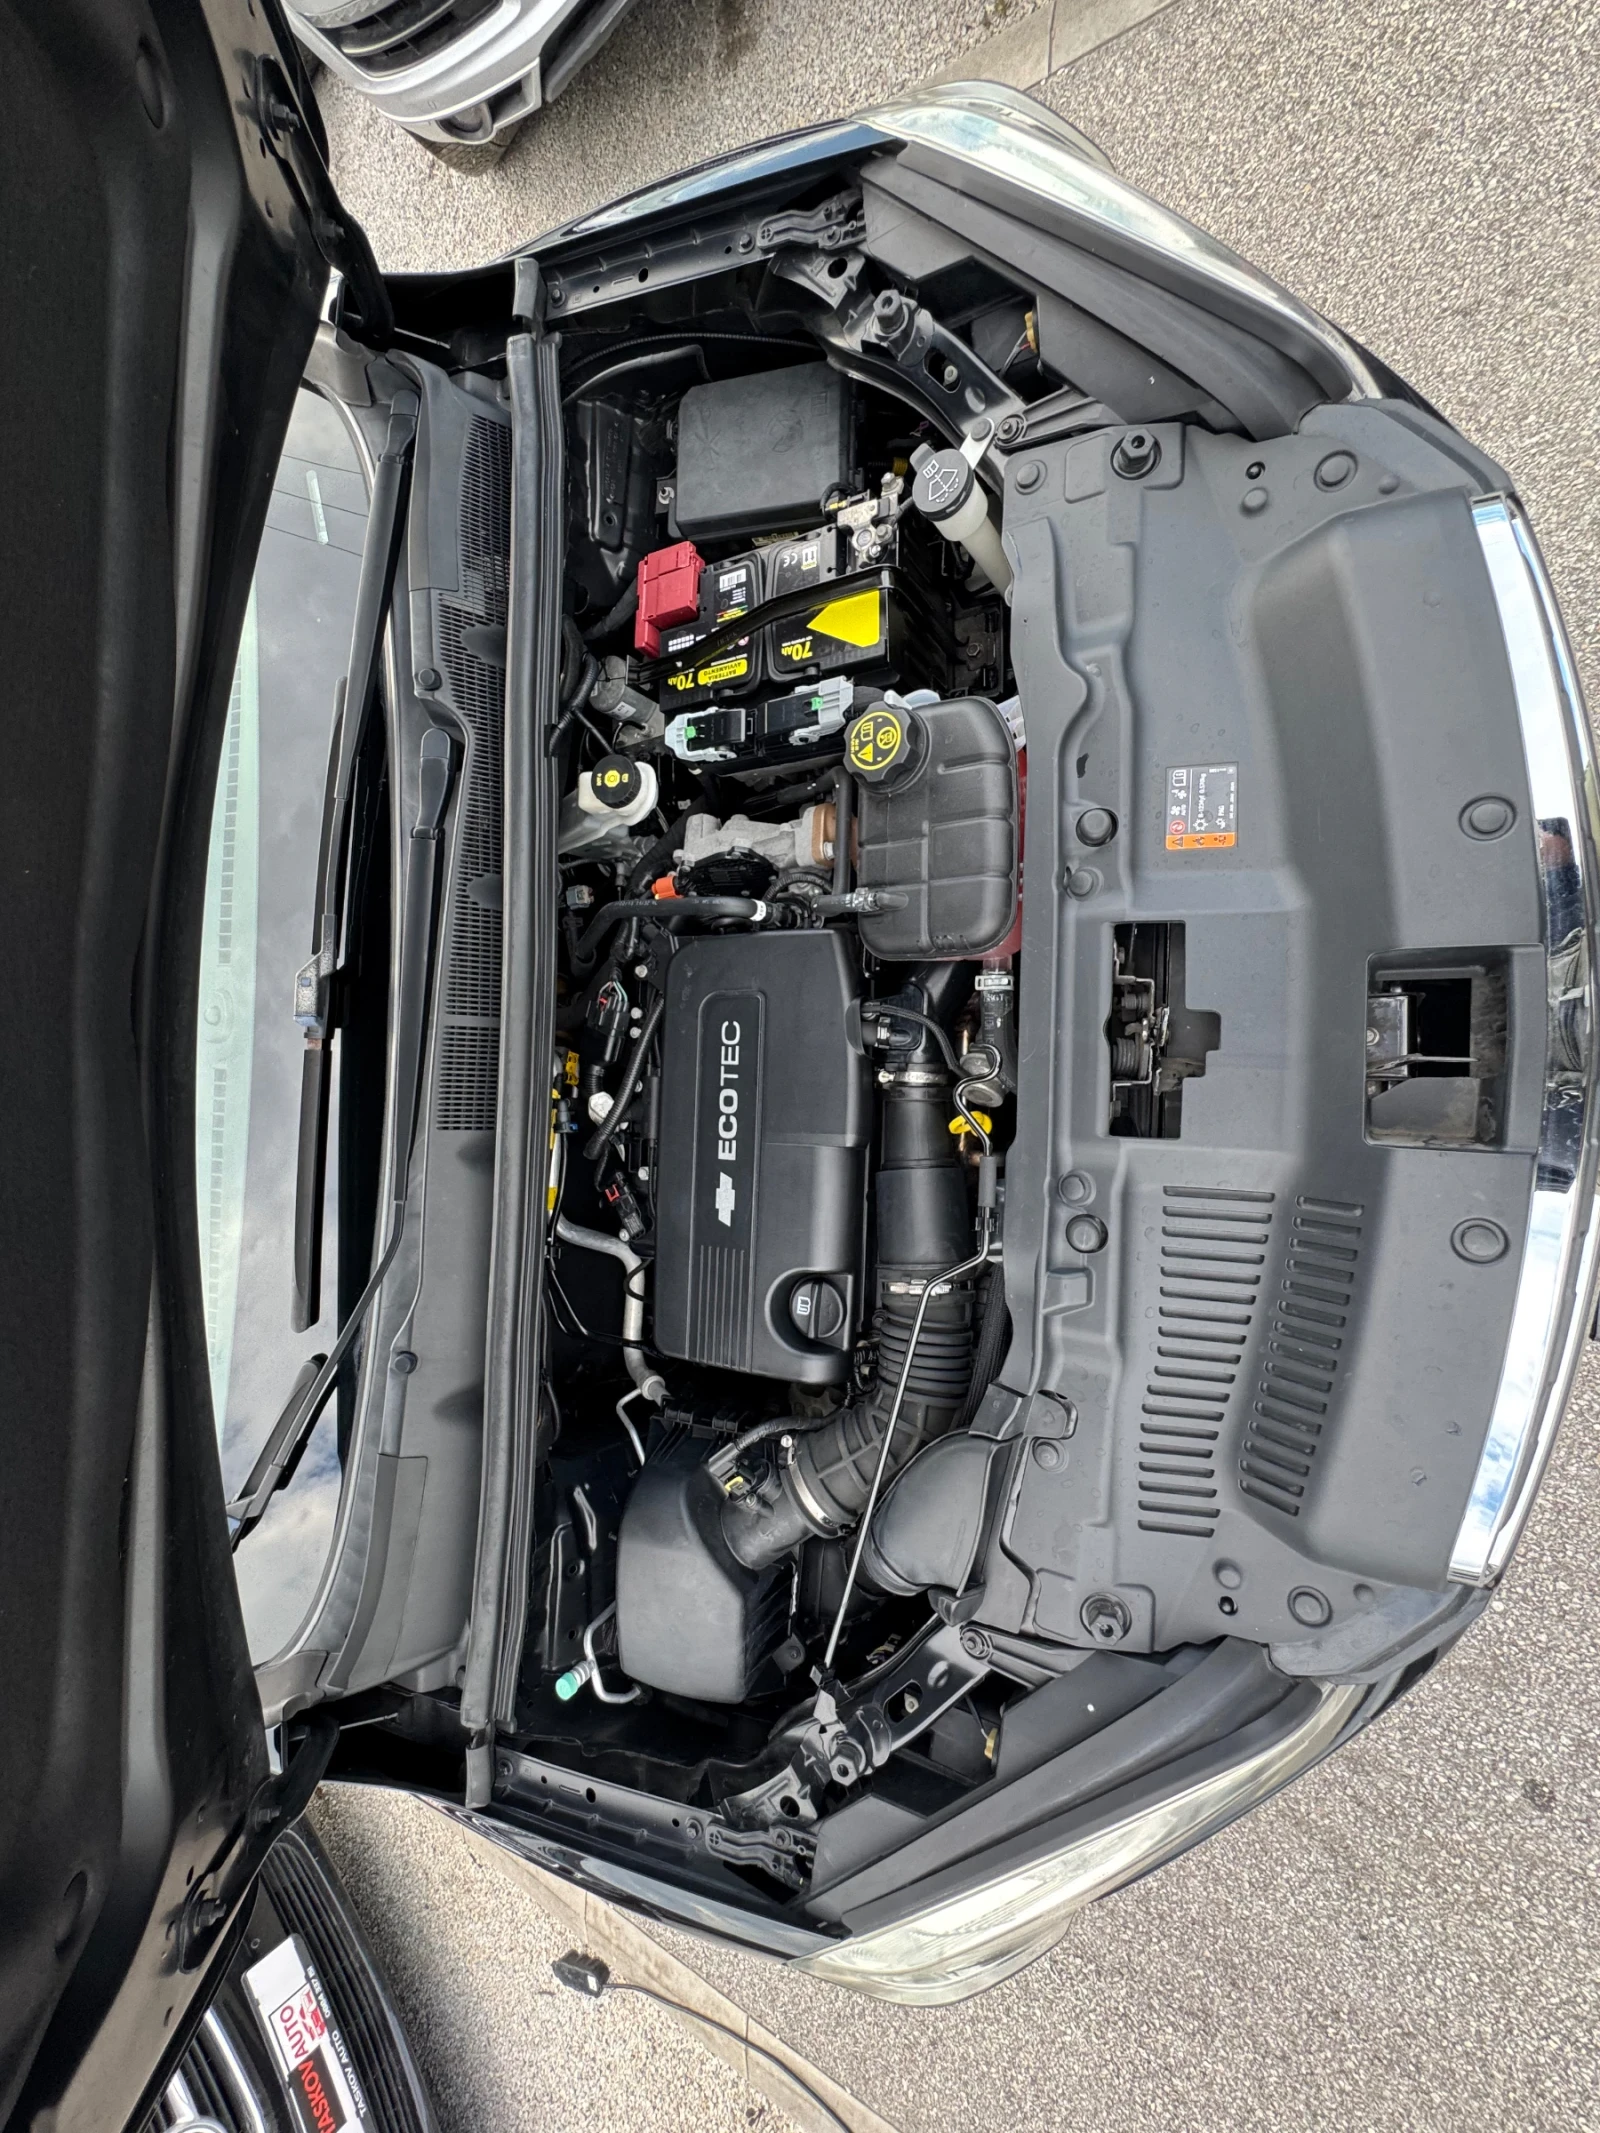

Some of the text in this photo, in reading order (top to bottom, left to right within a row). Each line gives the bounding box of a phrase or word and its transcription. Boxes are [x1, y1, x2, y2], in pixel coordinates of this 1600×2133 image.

[781, 641, 813, 661] 70Ah
[667, 672, 695, 691] 70Ah
[704, 662, 741, 676] AVVIAMENTO
[708, 670, 736, 681] BATTERIA
[718, 1020, 740, 1161] ECOTEC
[332, 2030, 349, 2064] AUTO
[280, 2005, 336, 2133] TASKOV AUTO
[344, 2066, 367, 2118] TASKOV
